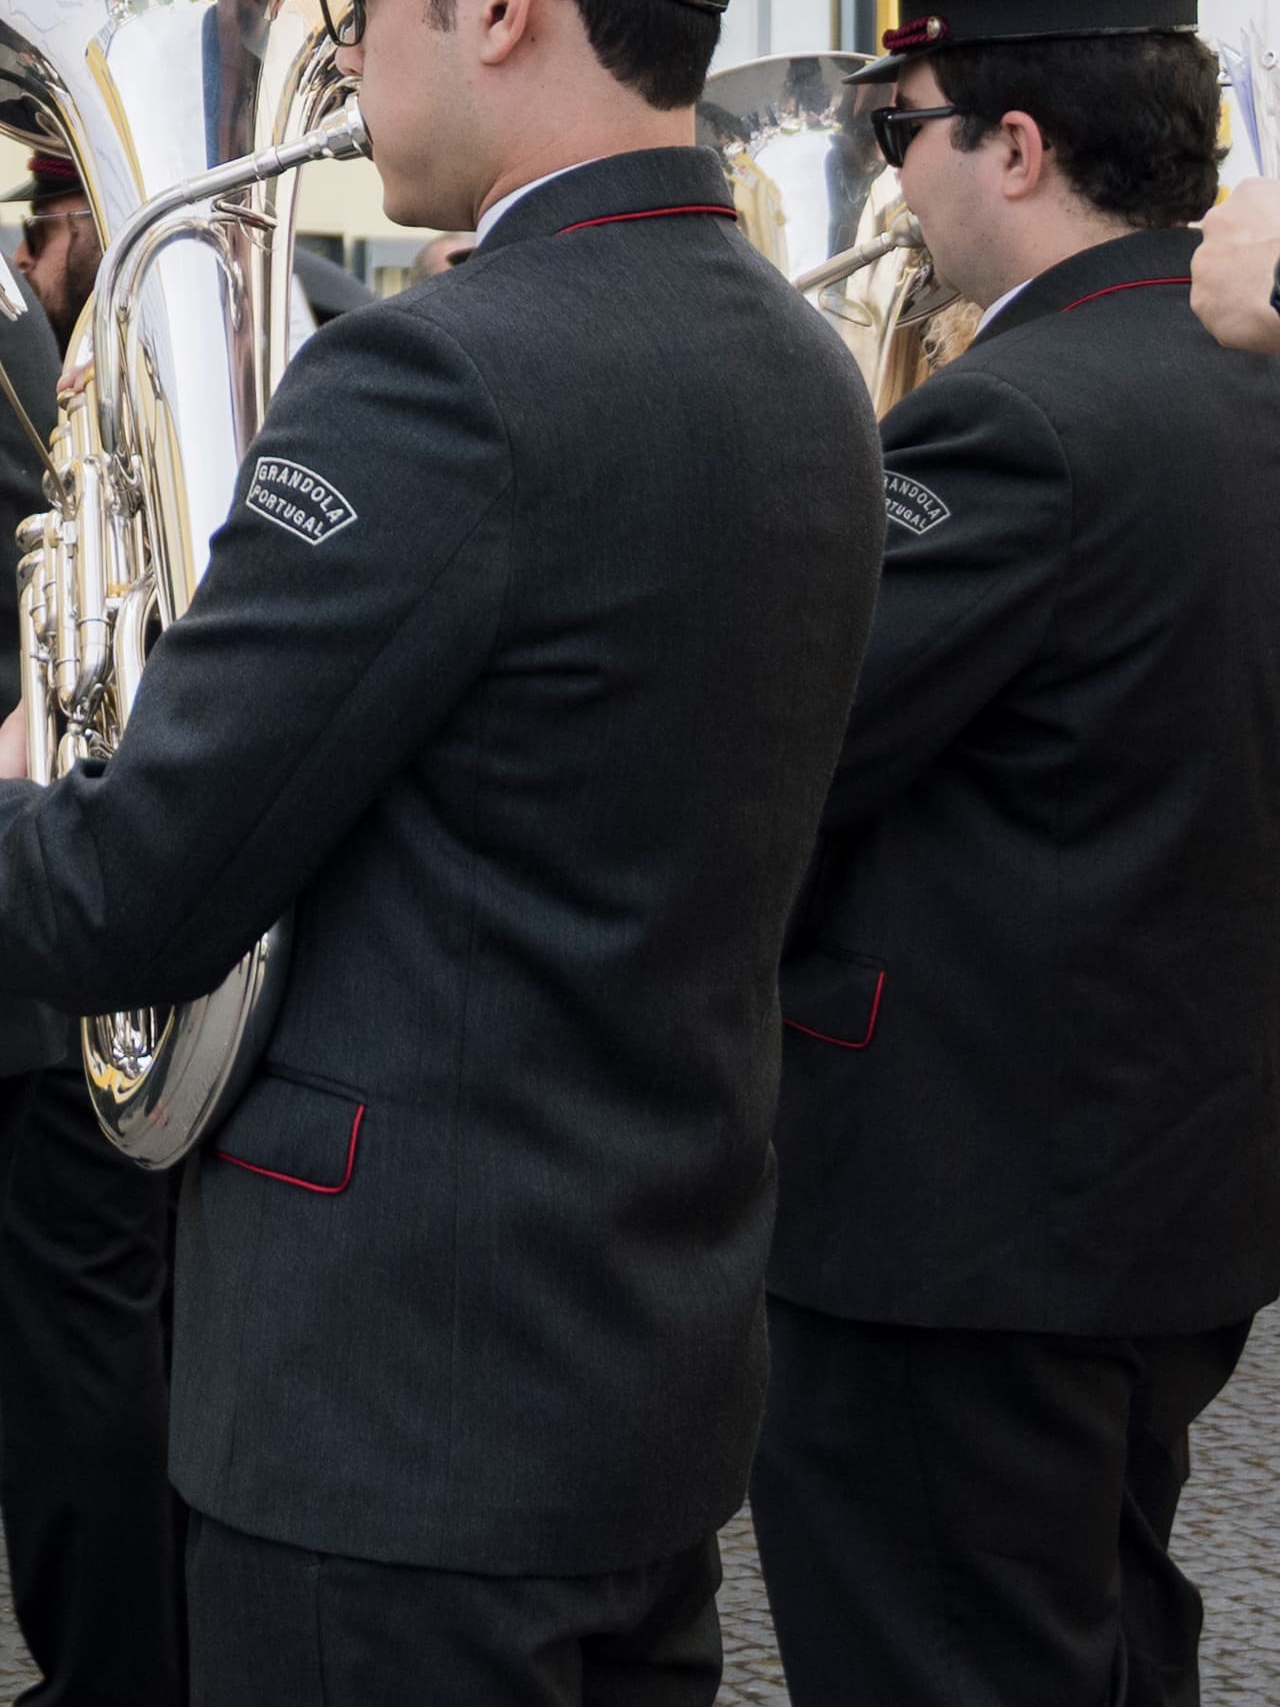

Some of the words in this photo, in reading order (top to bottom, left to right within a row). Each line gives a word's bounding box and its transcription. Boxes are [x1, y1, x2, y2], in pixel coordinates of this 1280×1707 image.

[249, 484, 324, 536] PORTUGAL
[258, 464, 345, 524] GRANDOLA
[883, 477, 942, 520] RANDOLA
[885, 497, 929, 528] RTUGAL
